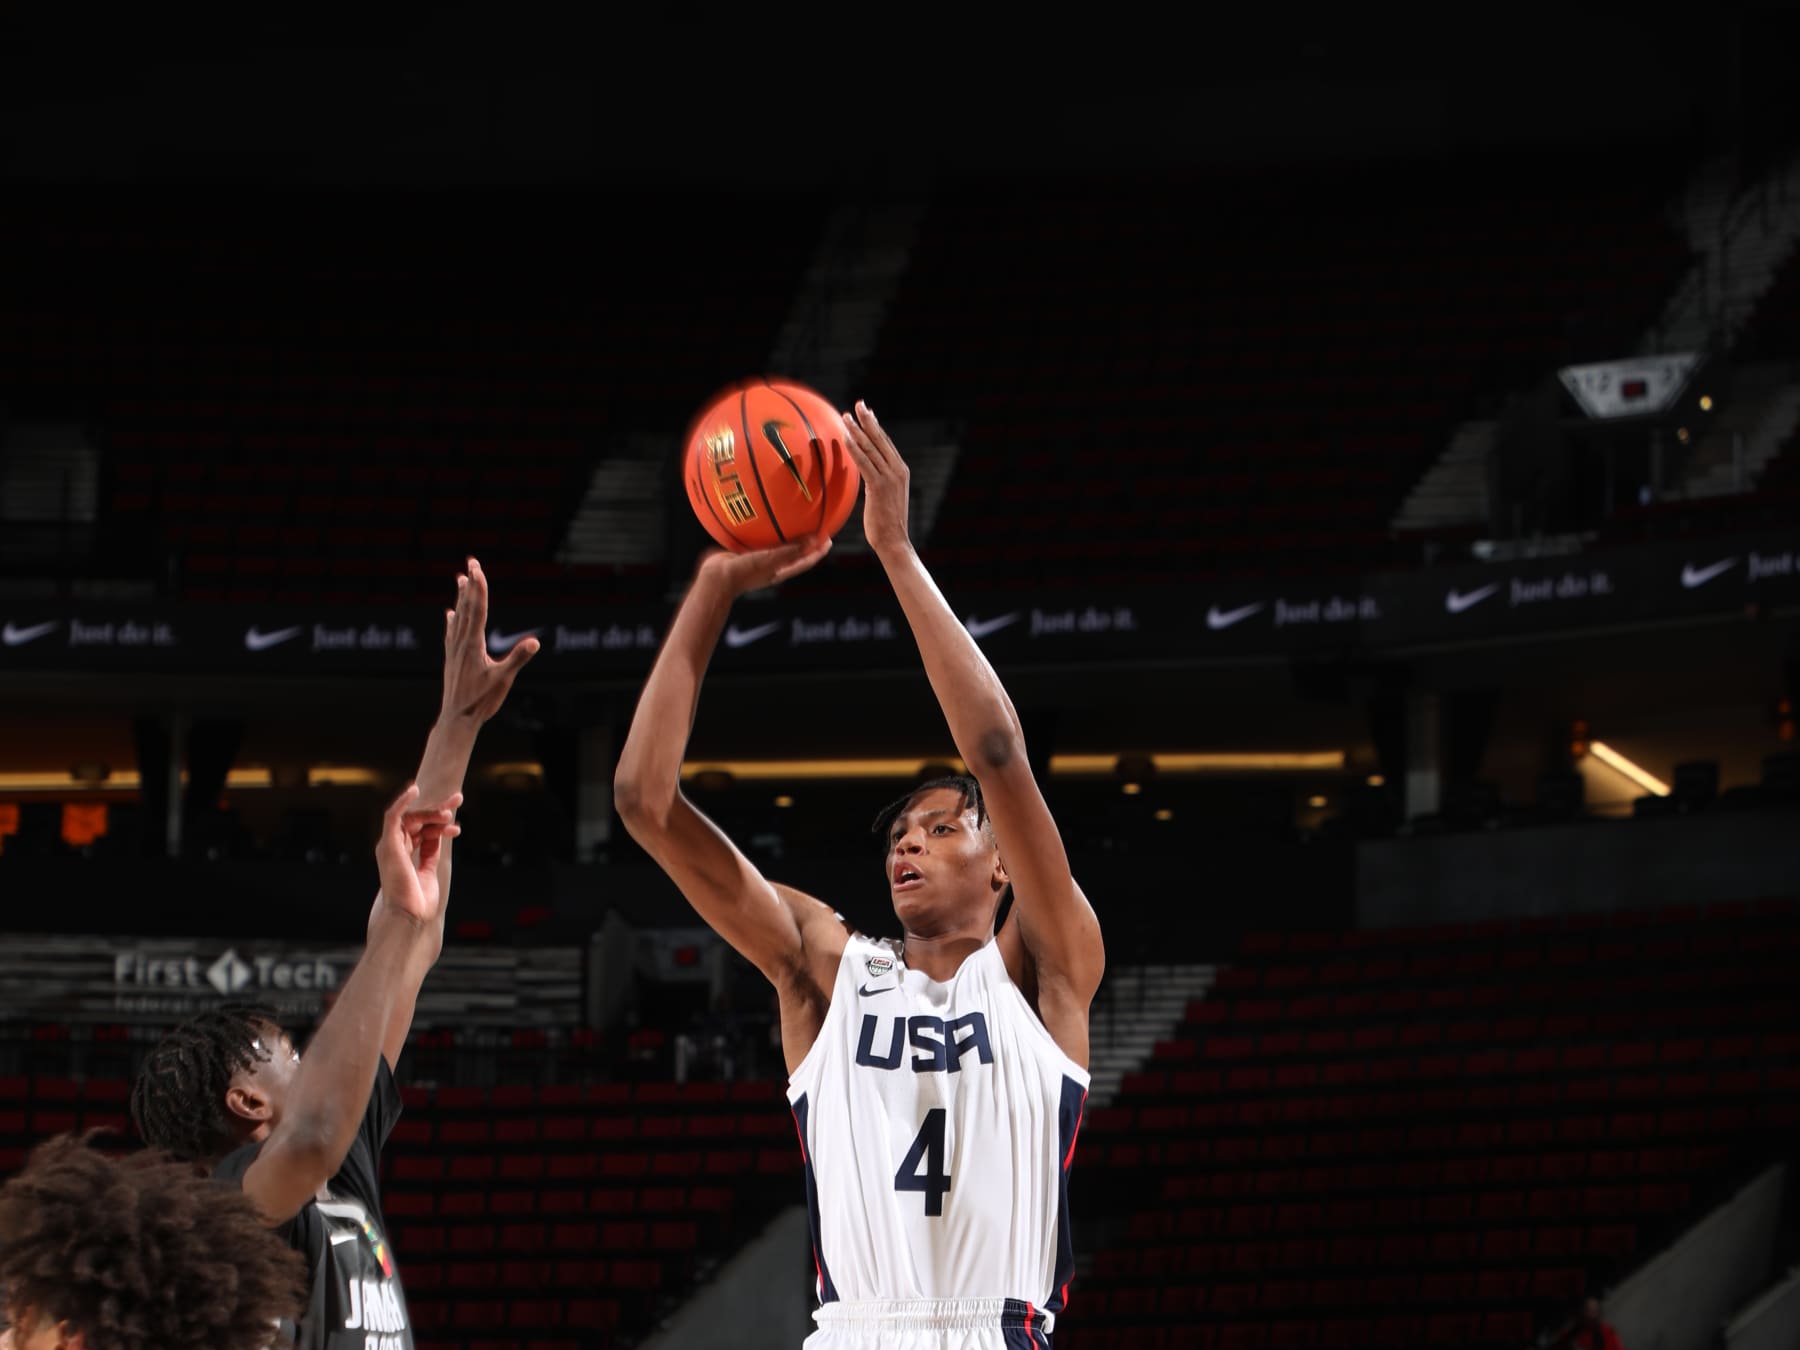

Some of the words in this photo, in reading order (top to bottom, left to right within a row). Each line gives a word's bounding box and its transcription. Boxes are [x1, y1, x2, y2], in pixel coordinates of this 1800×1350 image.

[707, 427, 758, 527] ELITE
[114, 953, 200, 987] First
[254, 955, 337, 988] Tech
[856, 1012, 994, 1074] USA
[894, 1108, 951, 1217] 4
